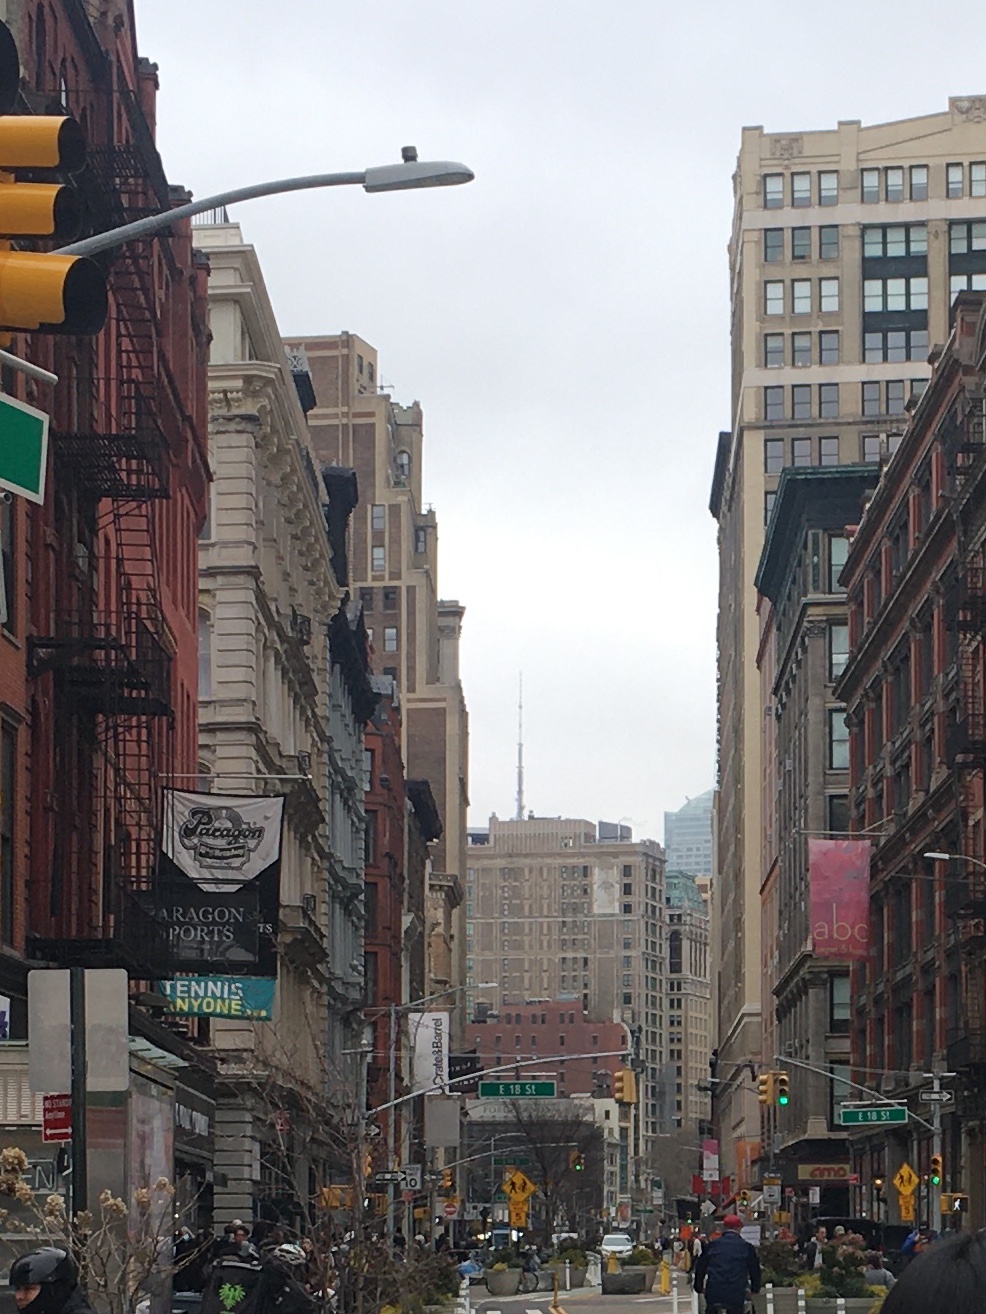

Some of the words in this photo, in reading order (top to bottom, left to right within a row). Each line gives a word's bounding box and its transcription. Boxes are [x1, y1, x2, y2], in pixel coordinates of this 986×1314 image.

[183, 809, 263, 846] Paragon
[814, 903, 868, 942] abc
[162, 925, 234, 941] PORTS
[163, 981, 243, 999] TENNIS
[500, 1085, 505, 1094] E
[509, 1084, 521, 1095] 18
[525, 1084, 536, 1095] St
[858, 1112, 863, 1120] E
[867, 1111, 878, 1120] 18
[881, 1109, 890, 1120] St
